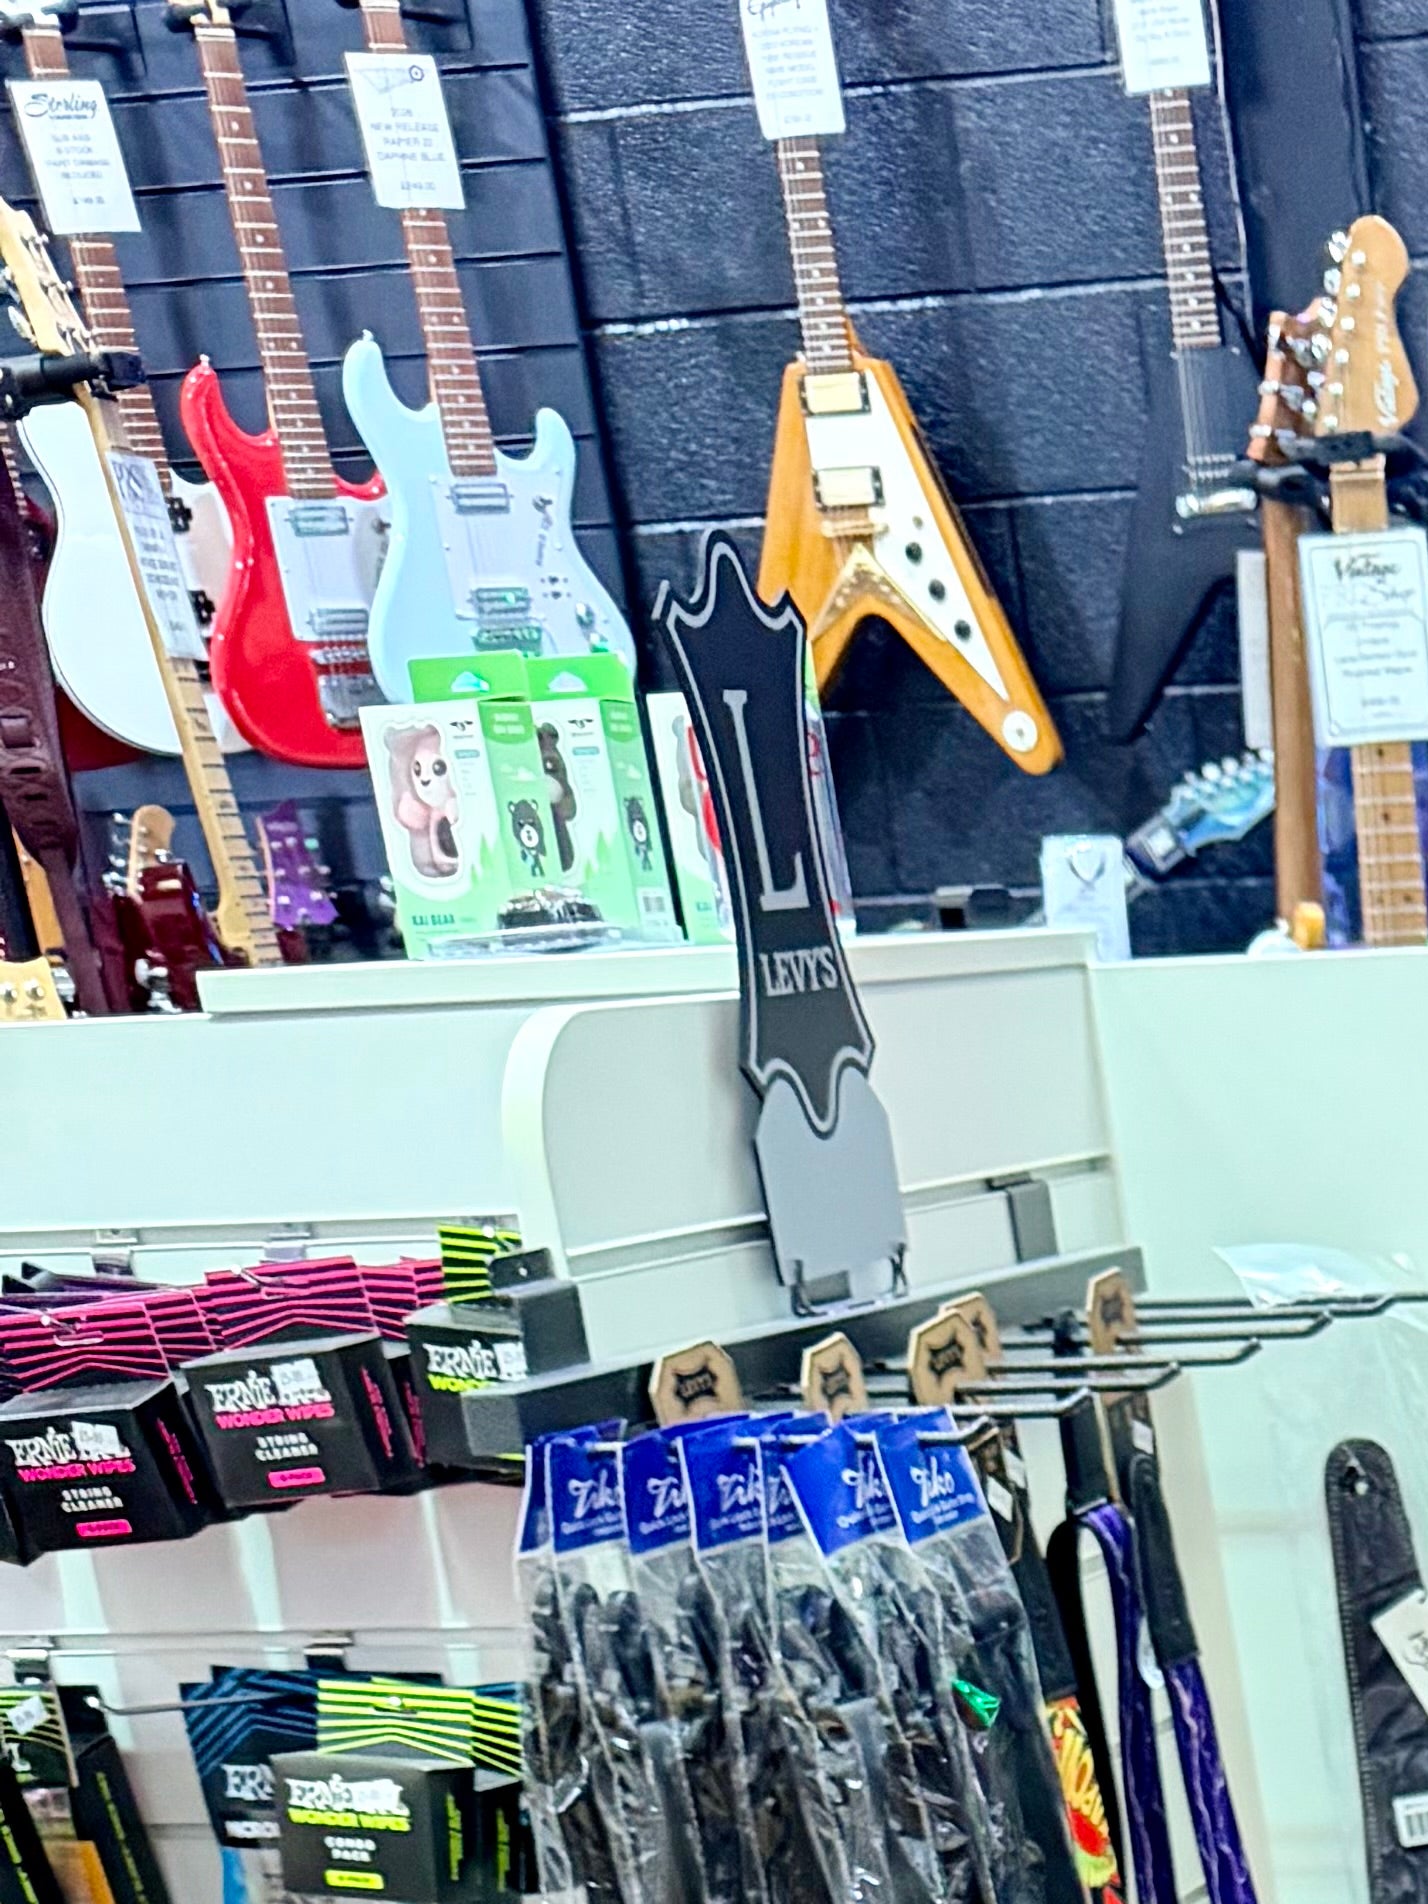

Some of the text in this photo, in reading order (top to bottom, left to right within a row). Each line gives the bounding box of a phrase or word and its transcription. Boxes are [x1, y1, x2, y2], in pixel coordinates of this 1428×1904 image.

[204, 1369, 277, 1413] ERNIE
[214, 1401, 336, 1430] WONDER WIPES
[5, 1426, 77, 1467] ERNIE
[17, 1462, 87, 1484] WONDER
